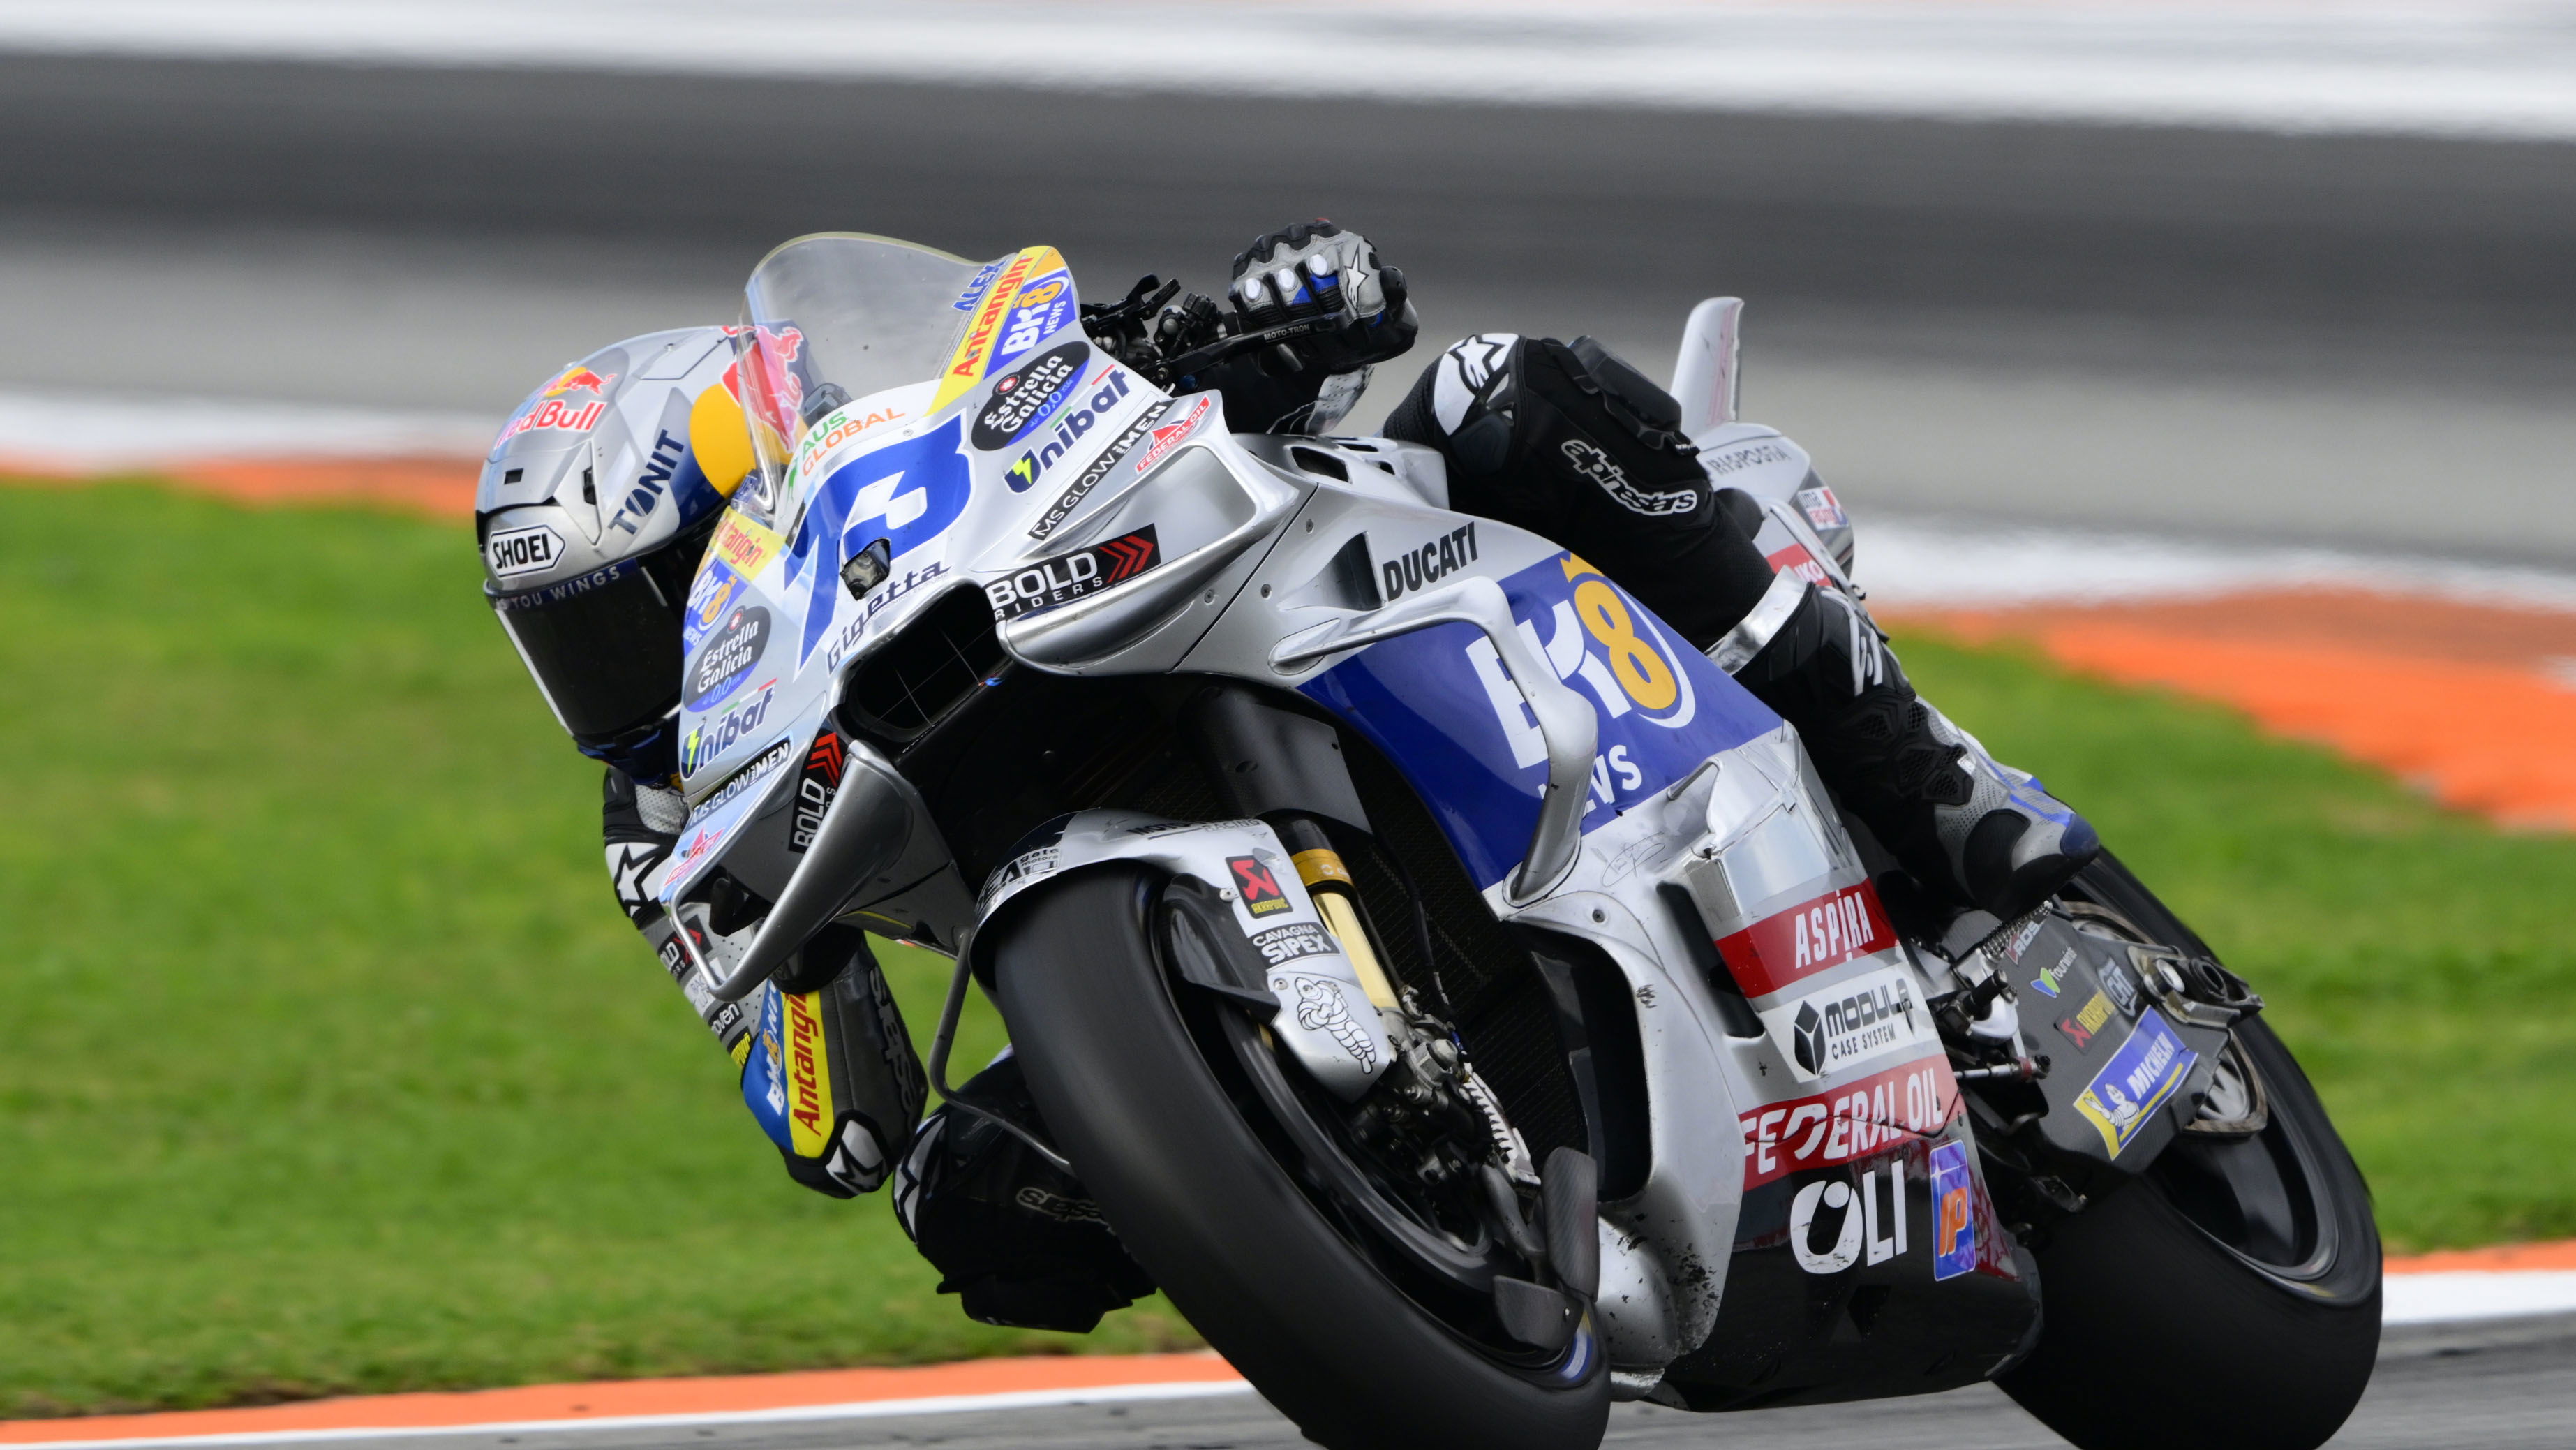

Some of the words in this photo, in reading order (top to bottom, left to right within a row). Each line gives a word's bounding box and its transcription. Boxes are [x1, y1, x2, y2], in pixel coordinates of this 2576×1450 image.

[952, 260, 1006, 311] ALEX
[1043, 300, 1066, 334] NEWS
[533, 400, 608, 433] Bull
[985, 355, 1063, 430] Estrella
[1001, 364, 1073, 432] Galicia
[803, 408, 905, 476] GLOBAL
[804, 411, 849, 454] AUS
[1004, 369, 1129, 493] Unibat
[1139, 422, 1190, 469] FEDERAL
[1189, 404, 1207, 425] OIL
[1032, 509, 1065, 536] MS
[1062, 452, 1116, 508] GLOW
[1118, 406, 1167, 448] MEN
[1561, 439, 1697, 516] alpinestars
[493, 533, 551, 570] SHOEI
[985, 552, 1098, 610] BOLD
[1383, 521, 1478, 602] DUCATI
[510, 593, 542, 609] YOU
[550, 566, 620, 600] WINGS
[994, 577, 1103, 621] RIDERS
[700, 620, 759, 672] Estrella
[826, 561, 951, 676] Gigetta
[698, 645, 752, 693] Galicia
[680, 686, 775, 778] Unibat
[712, 769, 750, 810] GLOW
[754, 742, 789, 778] MEN
[793, 778, 825, 847] BOLD
[1253, 924, 1319, 946] CAVAGNA
[1261, 934, 1332, 963] SIPEX
[1832, 1037, 1858, 1060] CASE
[1862, 1023, 1896, 1049] SYSTEM
[1741, 1081, 1902, 1174] FEDERAL
[1907, 1068, 1943, 1134] OIL
